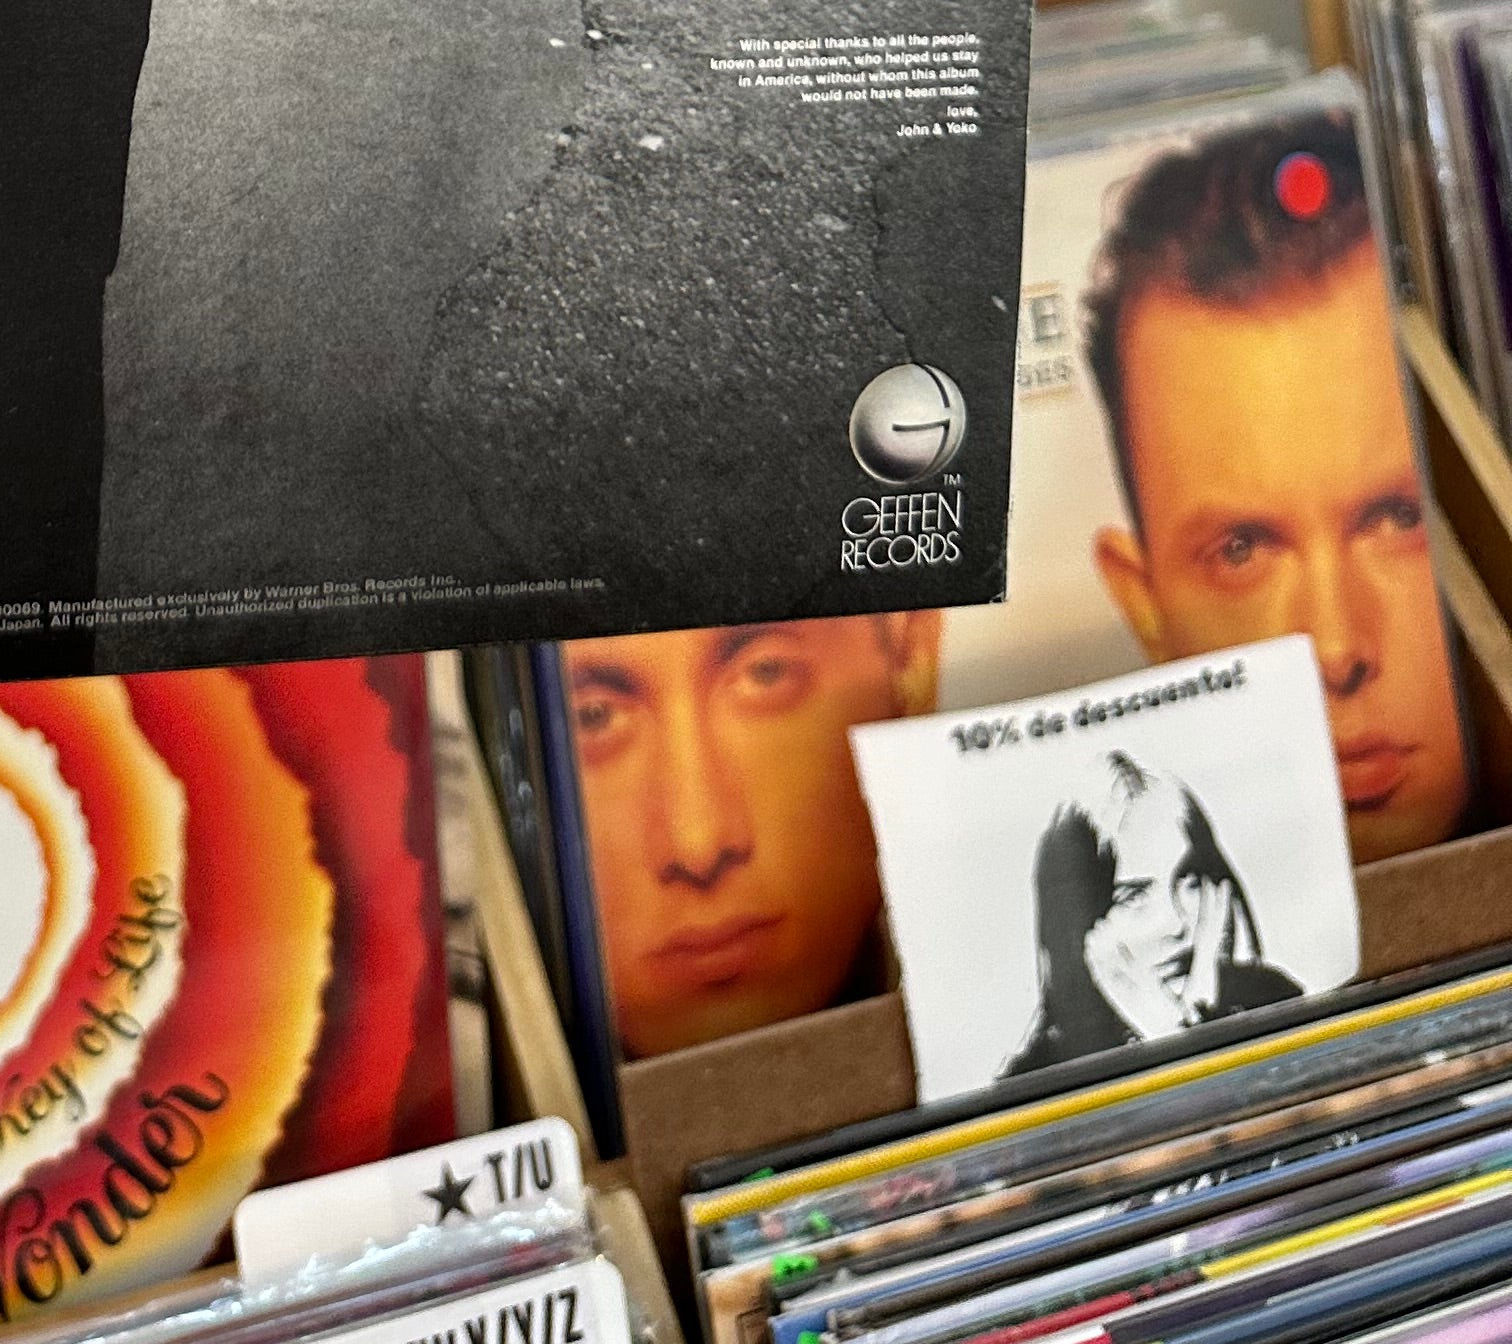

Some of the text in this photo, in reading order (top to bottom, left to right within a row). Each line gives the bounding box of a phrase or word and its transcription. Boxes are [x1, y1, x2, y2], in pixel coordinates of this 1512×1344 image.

[739, 32, 980, 53] With special thanks to all the people,
[710, 51, 979, 71] known and unknown, who helped us stay
[738, 67, 980, 87] in America, without whom this album
[801, 84, 979, 103] would not have been made.
[947, 105, 979, 118] love,
[896, 121, 978, 137] John & Yoko
[841, 490, 962, 537] GEFFEN
[841, 530, 961, 570] RECORDS
[950, 716, 1022, 751] 10%
[1028, 709, 1067, 737] de
[92, 873, 182, 993] Life
[74, 997, 144, 1057] of
[484, 1136, 556, 1204] T/U
